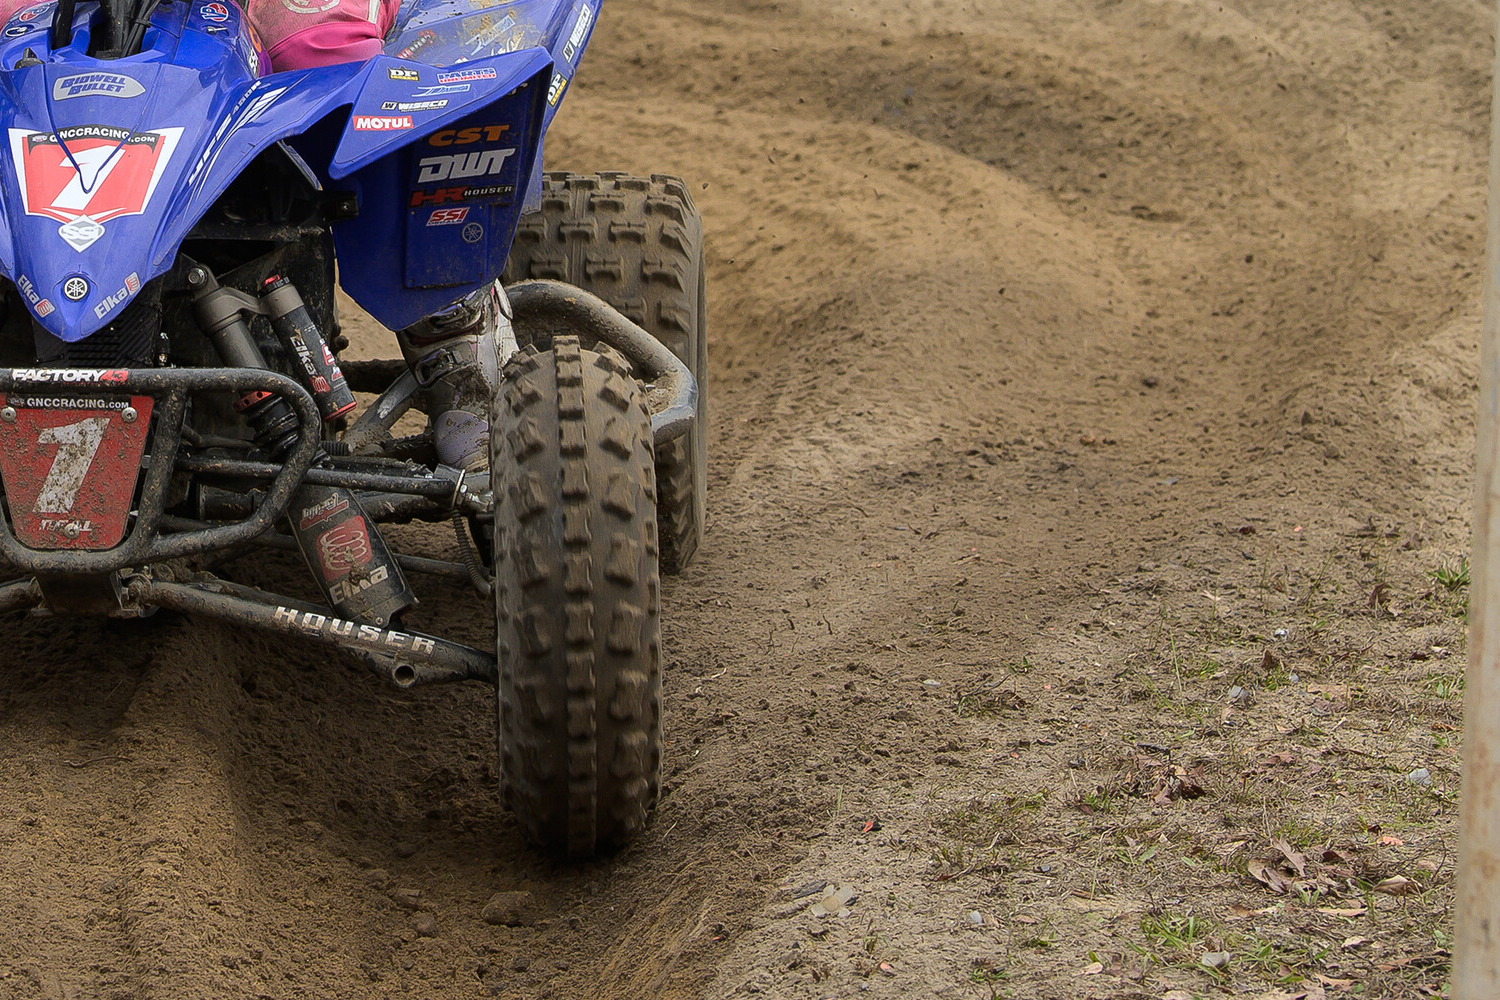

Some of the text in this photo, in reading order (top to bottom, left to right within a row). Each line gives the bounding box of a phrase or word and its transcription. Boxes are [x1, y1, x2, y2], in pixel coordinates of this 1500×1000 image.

[60, 74, 126, 88] BIDWELL
[68, 85, 125, 95] BULLET
[398, 100, 448, 111] WISECO
[356, 117, 412, 130] MOTUL
[428, 125, 510, 147] CST
[418, 148, 516, 184] DWT
[50, 145, 126, 211] 1
[464, 185, 513, 198] HOUSER
[431, 208, 468, 222] SSI
[17, 274, 38, 304] Elka
[94, 287, 128, 320] Elka
[27, 397, 129, 410] GNCCRACING.COM
[33, 418, 111, 514] 1
[275, 606, 437, 656] HOUSER
